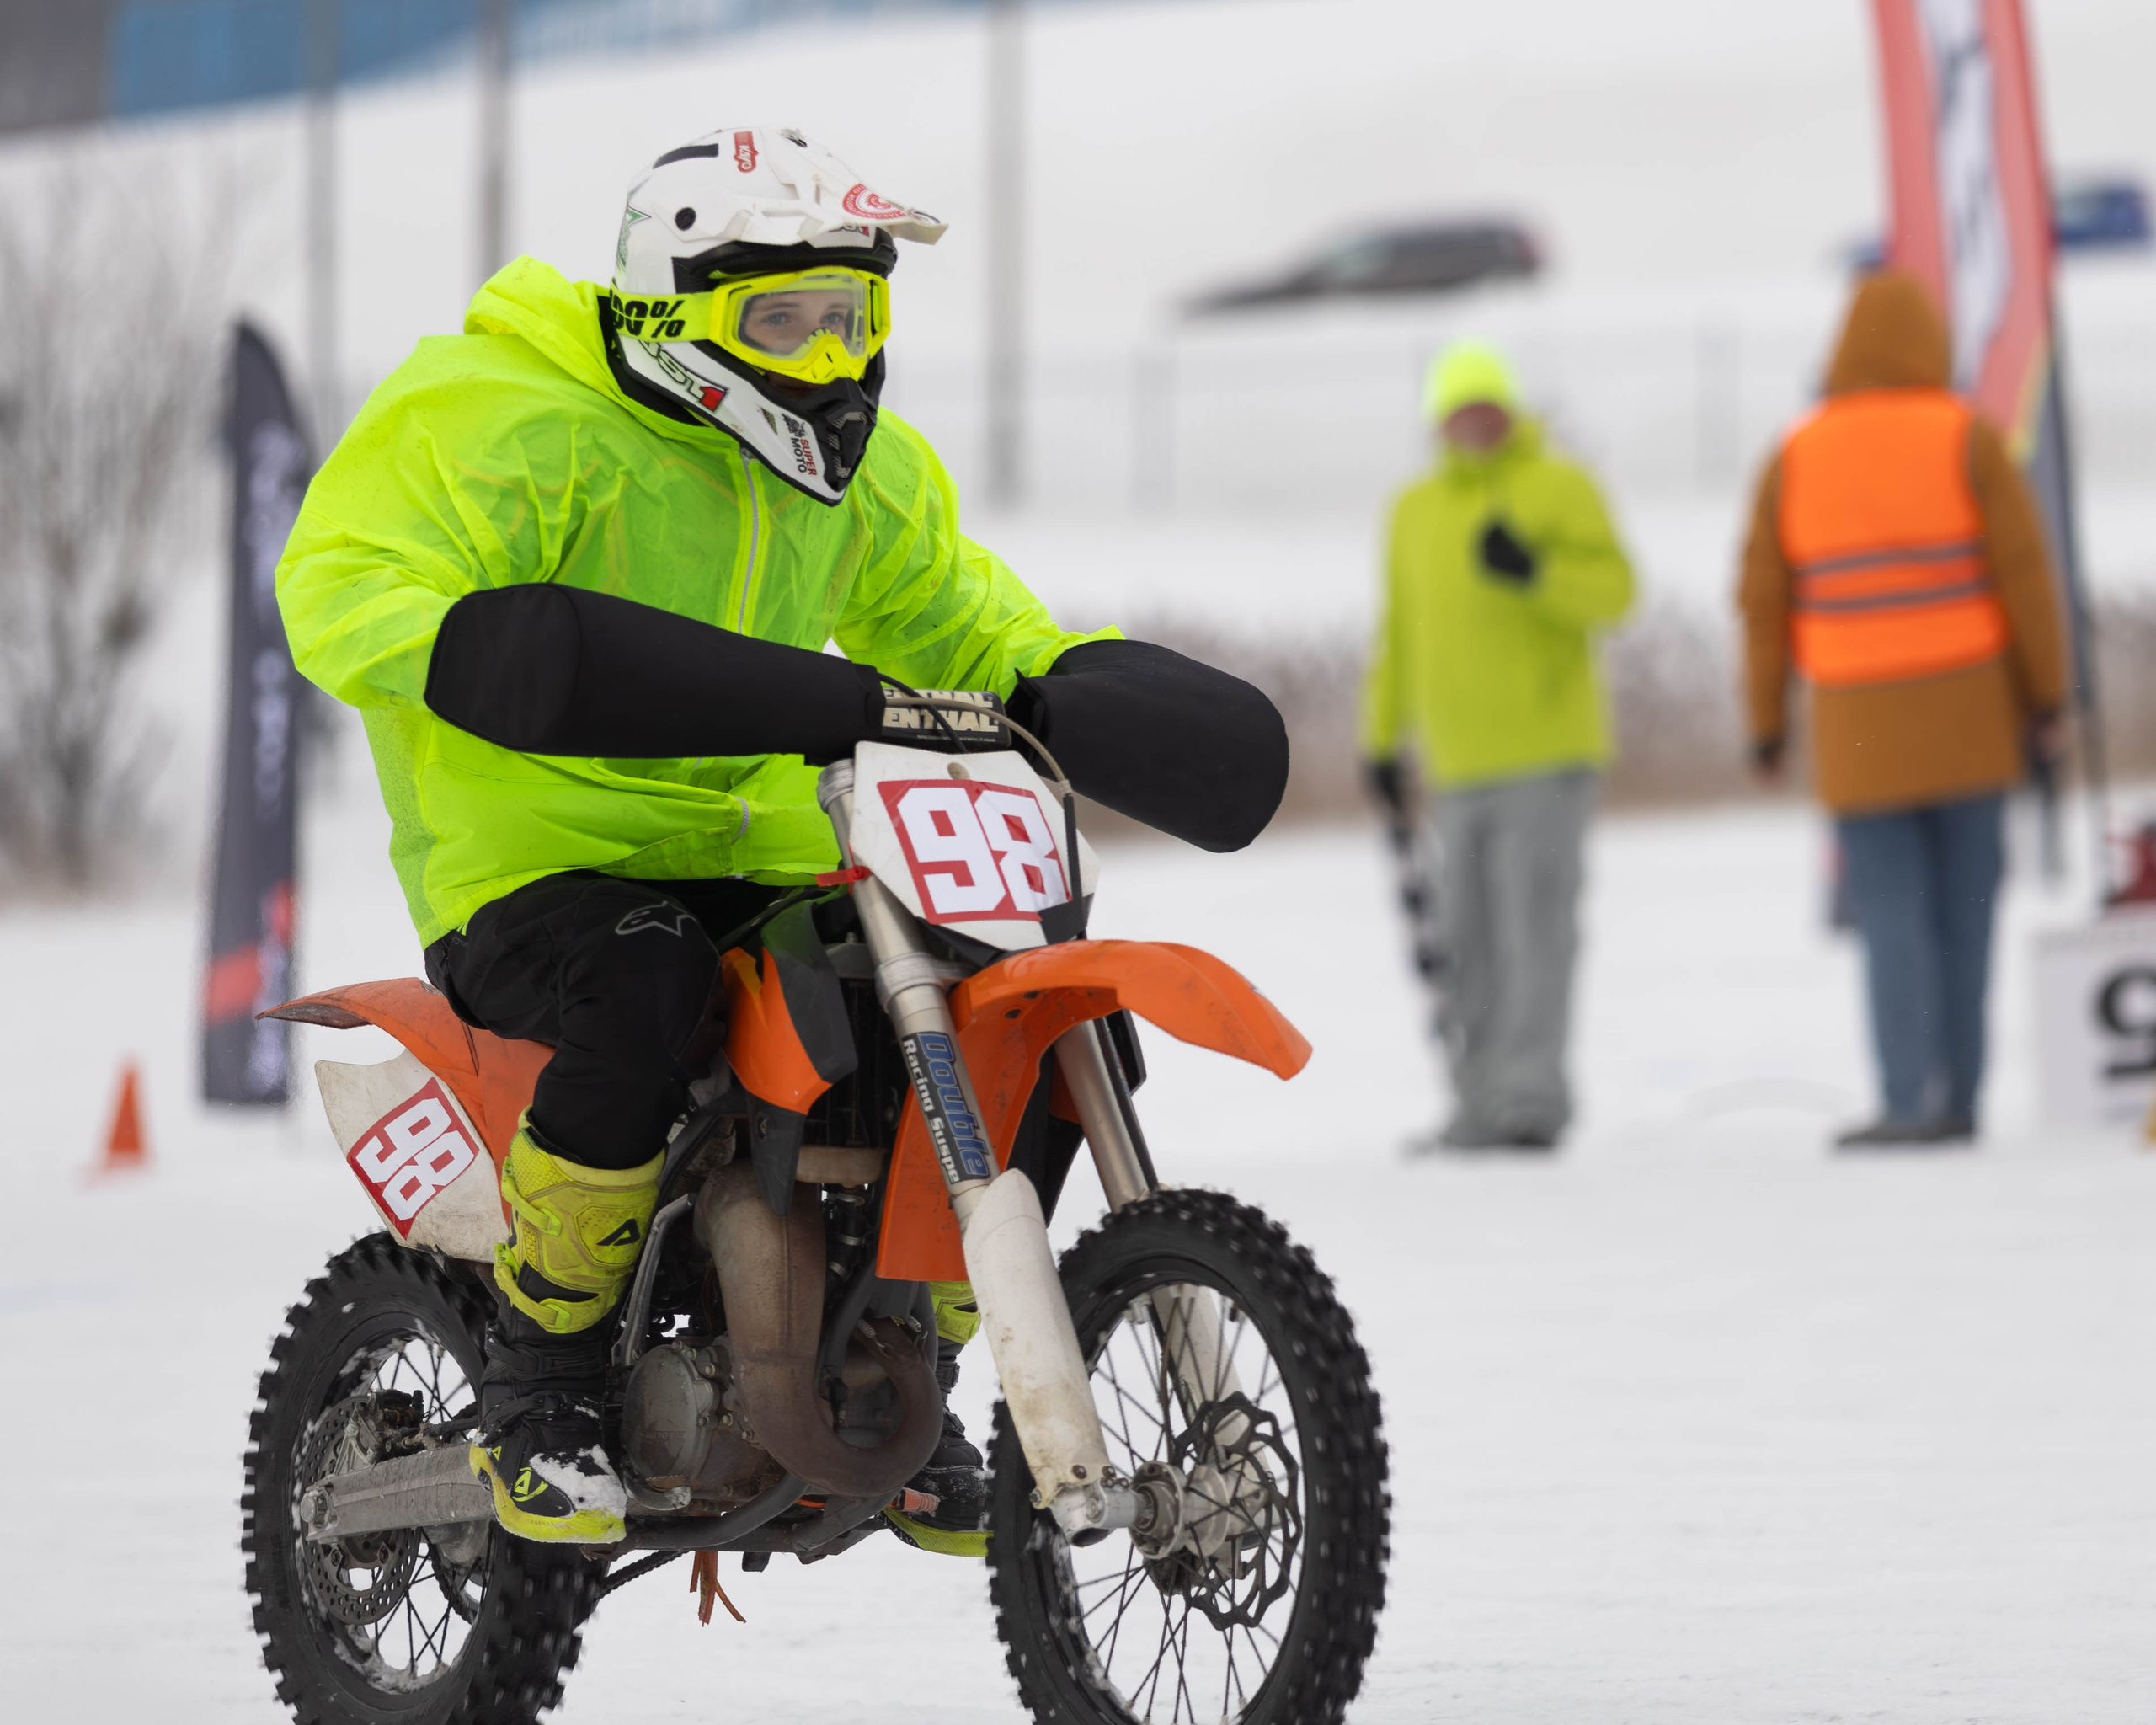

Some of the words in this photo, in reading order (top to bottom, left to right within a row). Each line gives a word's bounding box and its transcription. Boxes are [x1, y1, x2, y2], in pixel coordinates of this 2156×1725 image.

[611, 290, 686, 338] 00%
[791, 437, 807, 473] MOTO
[800, 438, 817, 476] SUPER
[883, 707, 999, 732] ENTHAL
[897, 788, 1068, 915] 98
[903, 1039, 935, 1112] Racing
[930, 1117, 960, 1183] Suspe
[917, 1032, 990, 1177] Double
[356, 1097, 475, 1221] 98
